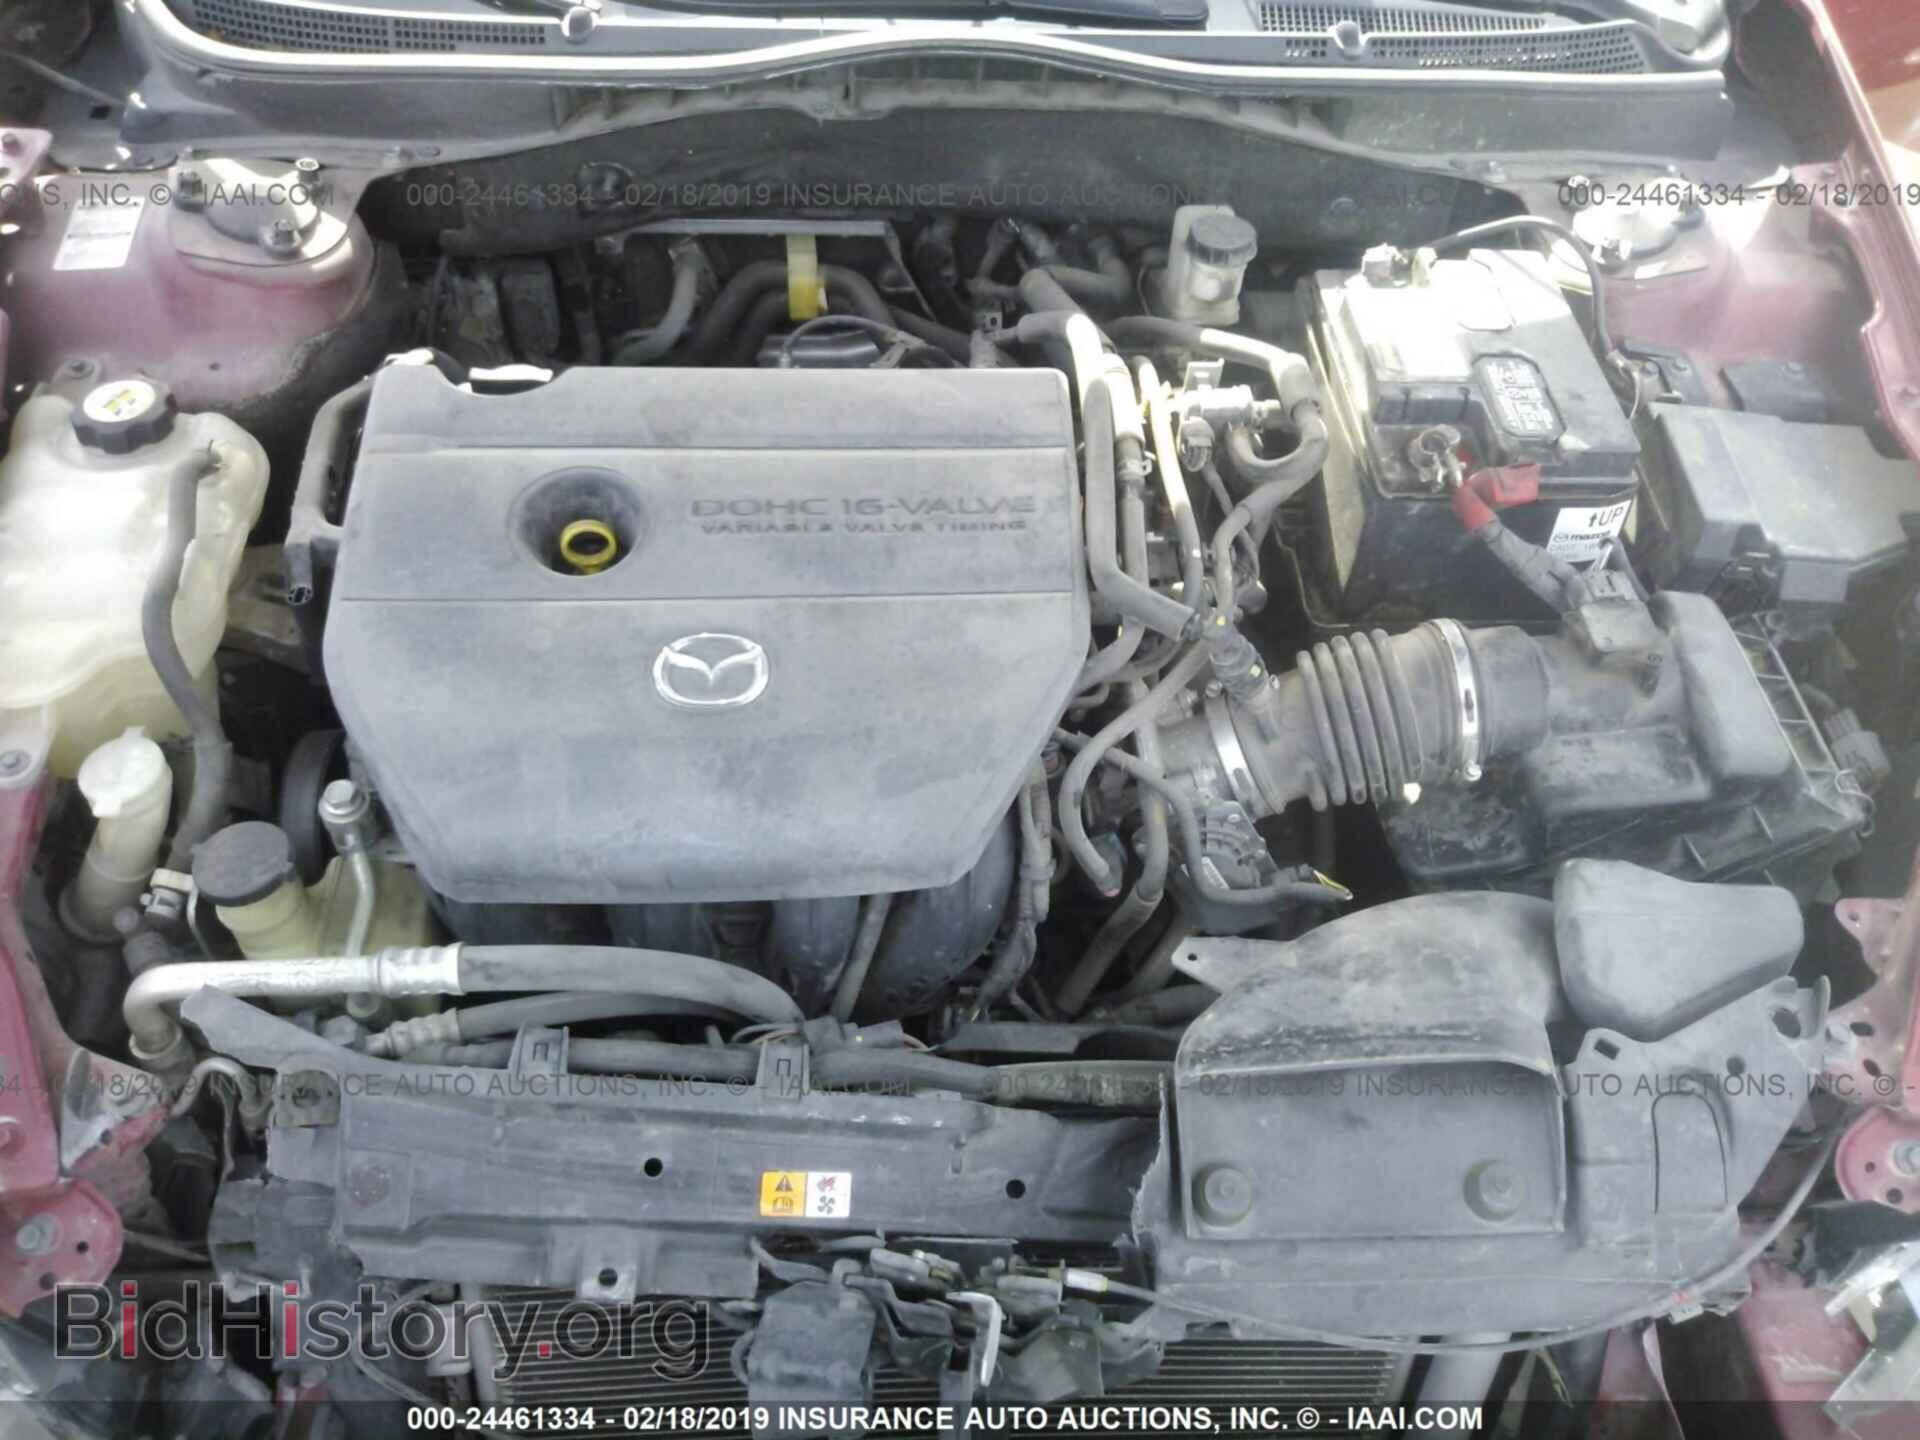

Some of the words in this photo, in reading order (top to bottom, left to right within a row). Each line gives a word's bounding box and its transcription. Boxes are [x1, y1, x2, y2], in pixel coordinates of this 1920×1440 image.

[691, 498, 829, 517] DOHC
[1598, 506, 1624, 526] UP
[843, 520, 924, 534] VALVE
